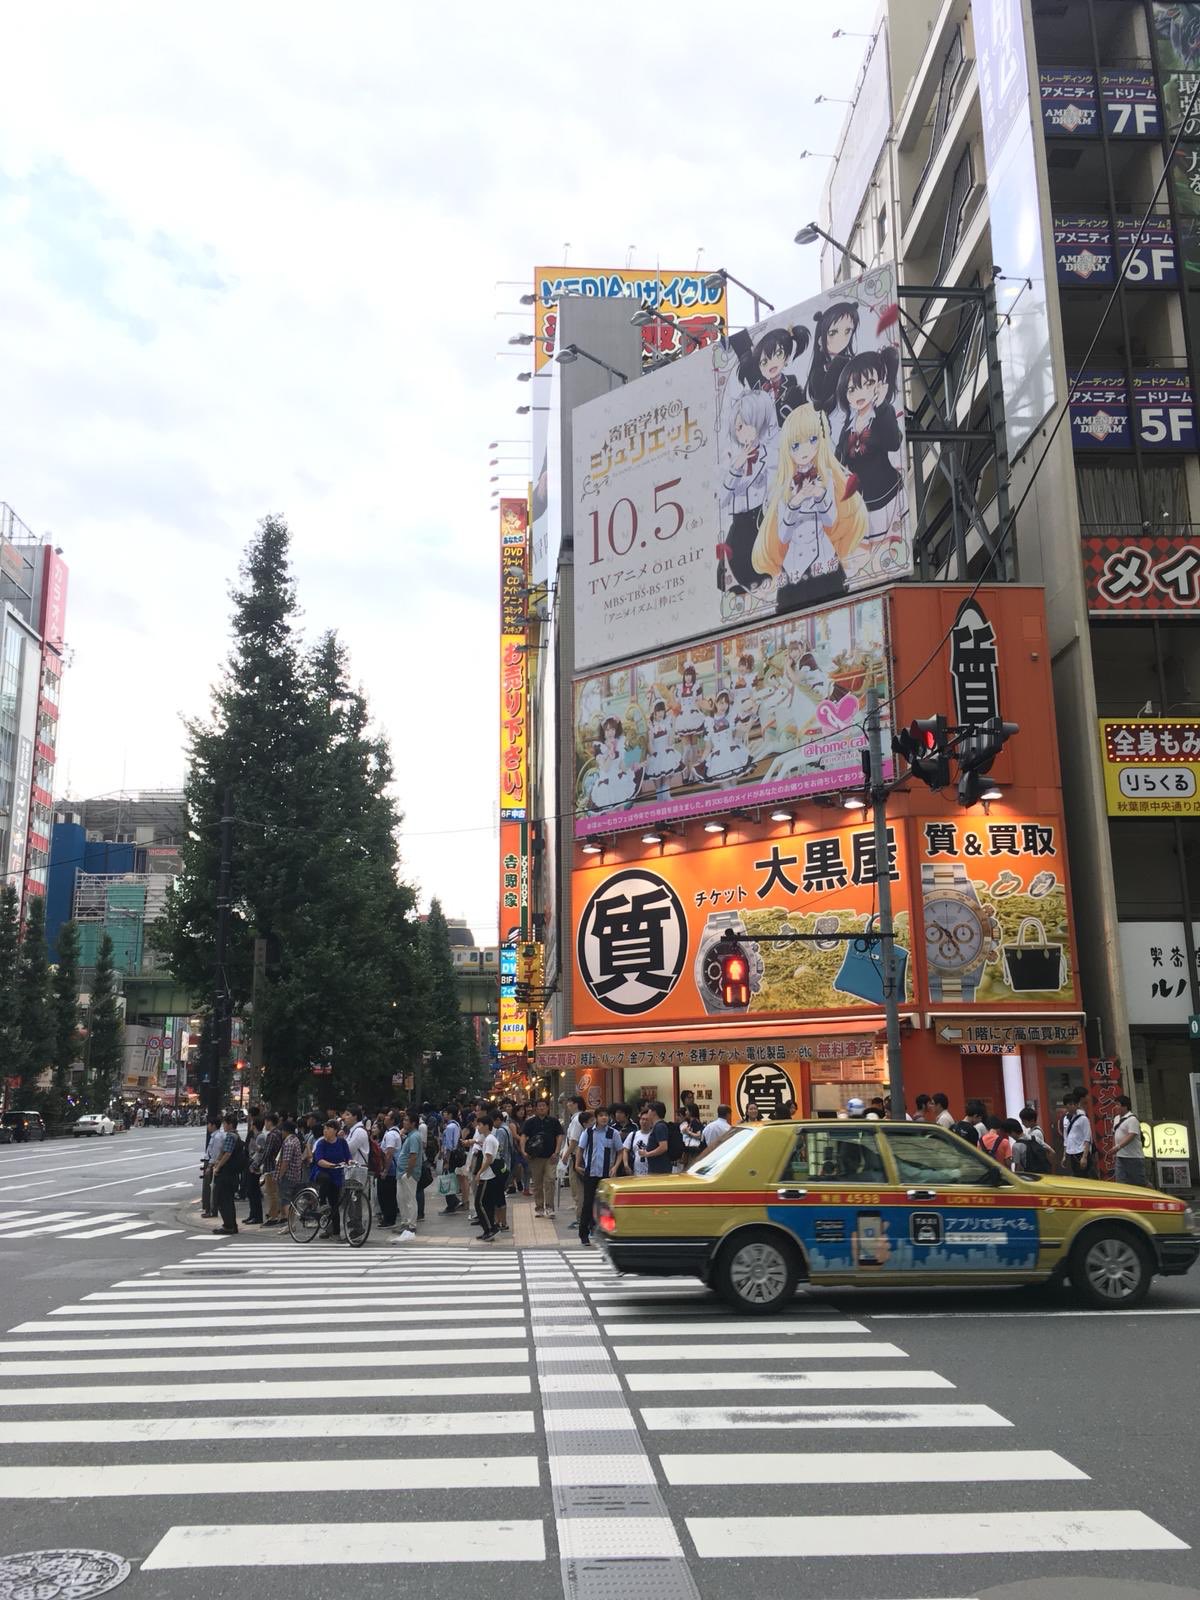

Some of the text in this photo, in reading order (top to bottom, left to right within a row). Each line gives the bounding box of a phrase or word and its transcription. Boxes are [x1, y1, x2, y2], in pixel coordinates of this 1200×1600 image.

[1041, 87, 1095, 98] アメニティ
[1108, 104, 1156, 134] 7F
[1055, 233, 1110, 243] アメニティ
[1122, 249, 1174, 281] 6F
[1070, 392, 1127, 403] アメニティ
[1073, 416, 1128, 425] AMENITY
[1140, 408, 1193, 442] 5F
[1080, 425, 1123, 433] DREAM
[588, 477, 685, 566] 10.5
[503, 548, 523, 556] DVD
[588, 547, 704, 596] TVアニメ on air
[506, 576, 520, 585] CD
[503, 596, 523, 604] アニメ
[1125, 773, 1190, 792] りらくる
[755, 829, 900, 899] 大黒屋
[695, 886, 747, 907] チケット
[590, 885, 677, 999] 質
[502, 1024, 524, 1032] AKIBA
[966, 1026, 1079, 1041] 1階にて高価買取中
[816, 1040, 873, 1059] 無料査定
[1095, 1061, 1114, 1077] 4F
[696, 1090, 713, 1100] 黒屋
[1157, 1147, 1187, 1155] ルノアール
[1038, 1197, 1082, 1208] TAXI
